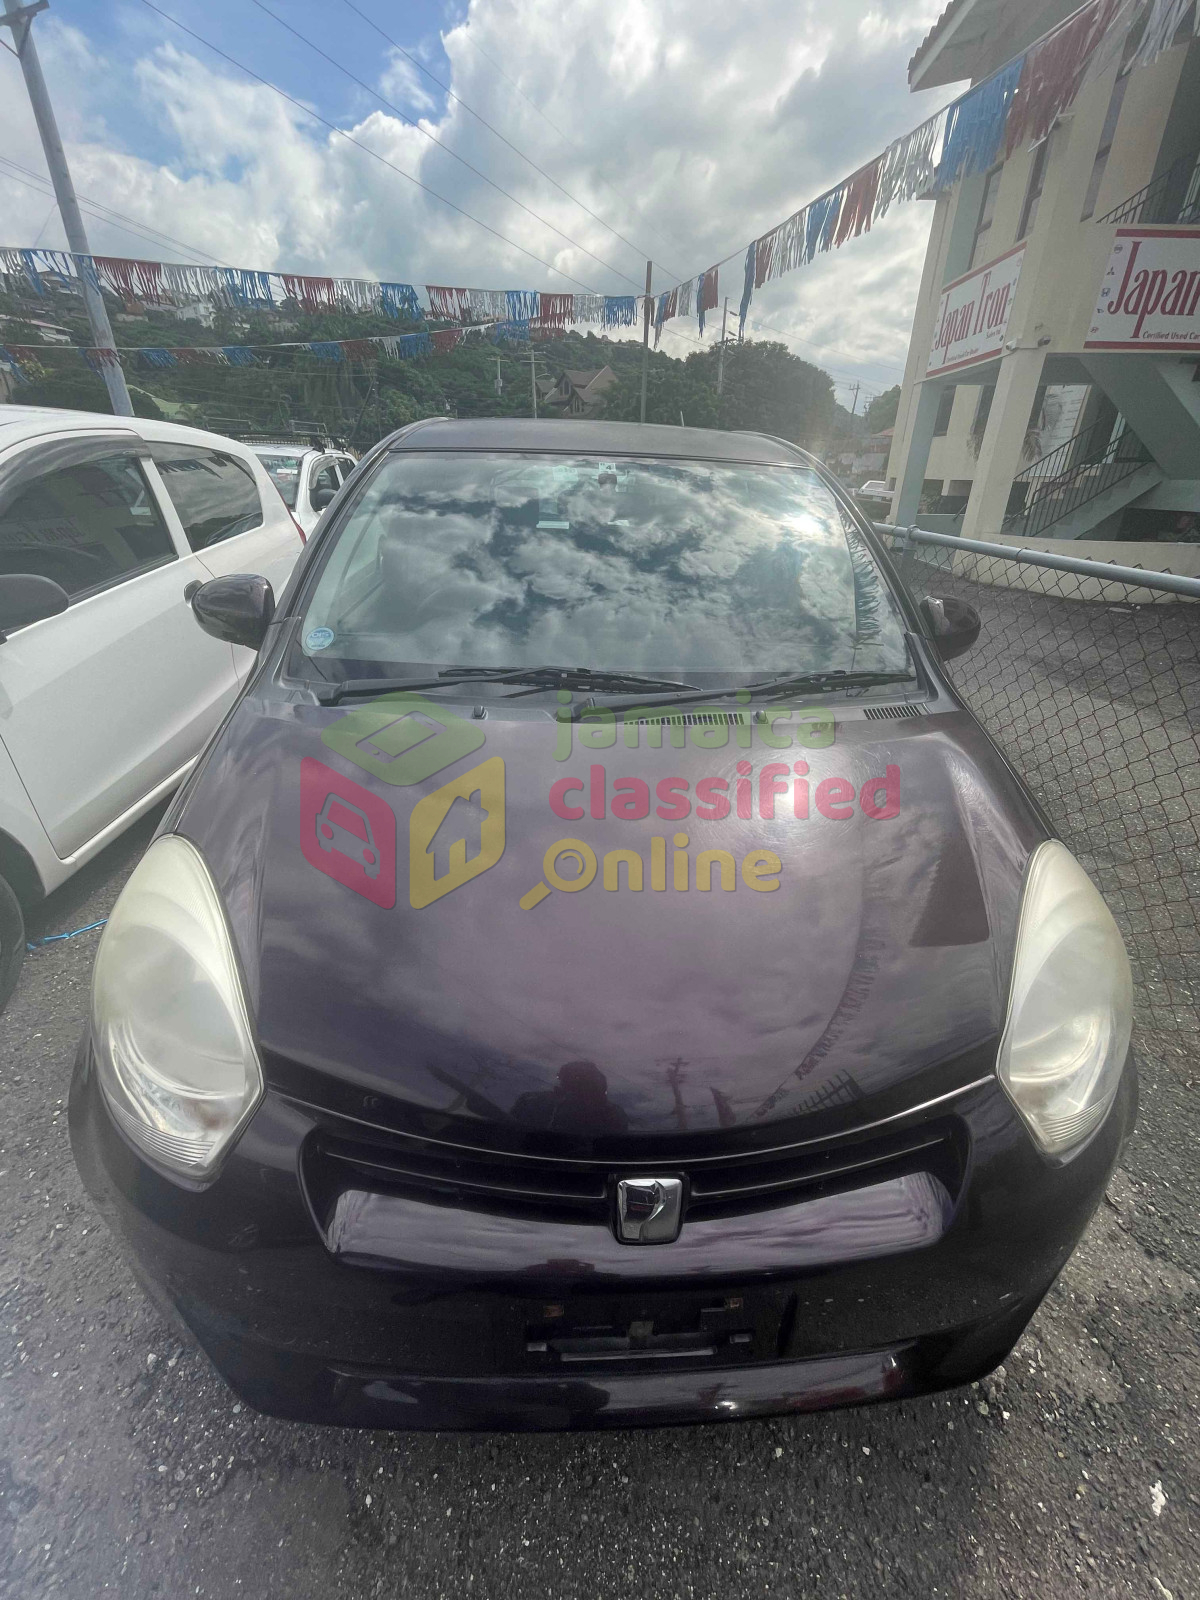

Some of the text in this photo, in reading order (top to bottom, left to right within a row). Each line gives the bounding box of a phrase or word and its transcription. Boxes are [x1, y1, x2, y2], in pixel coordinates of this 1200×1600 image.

[935, 271, 1011, 365] Japan Tron
[1107, 241, 1200, 338] Japan
[1170, 331, 1188, 340] Used
